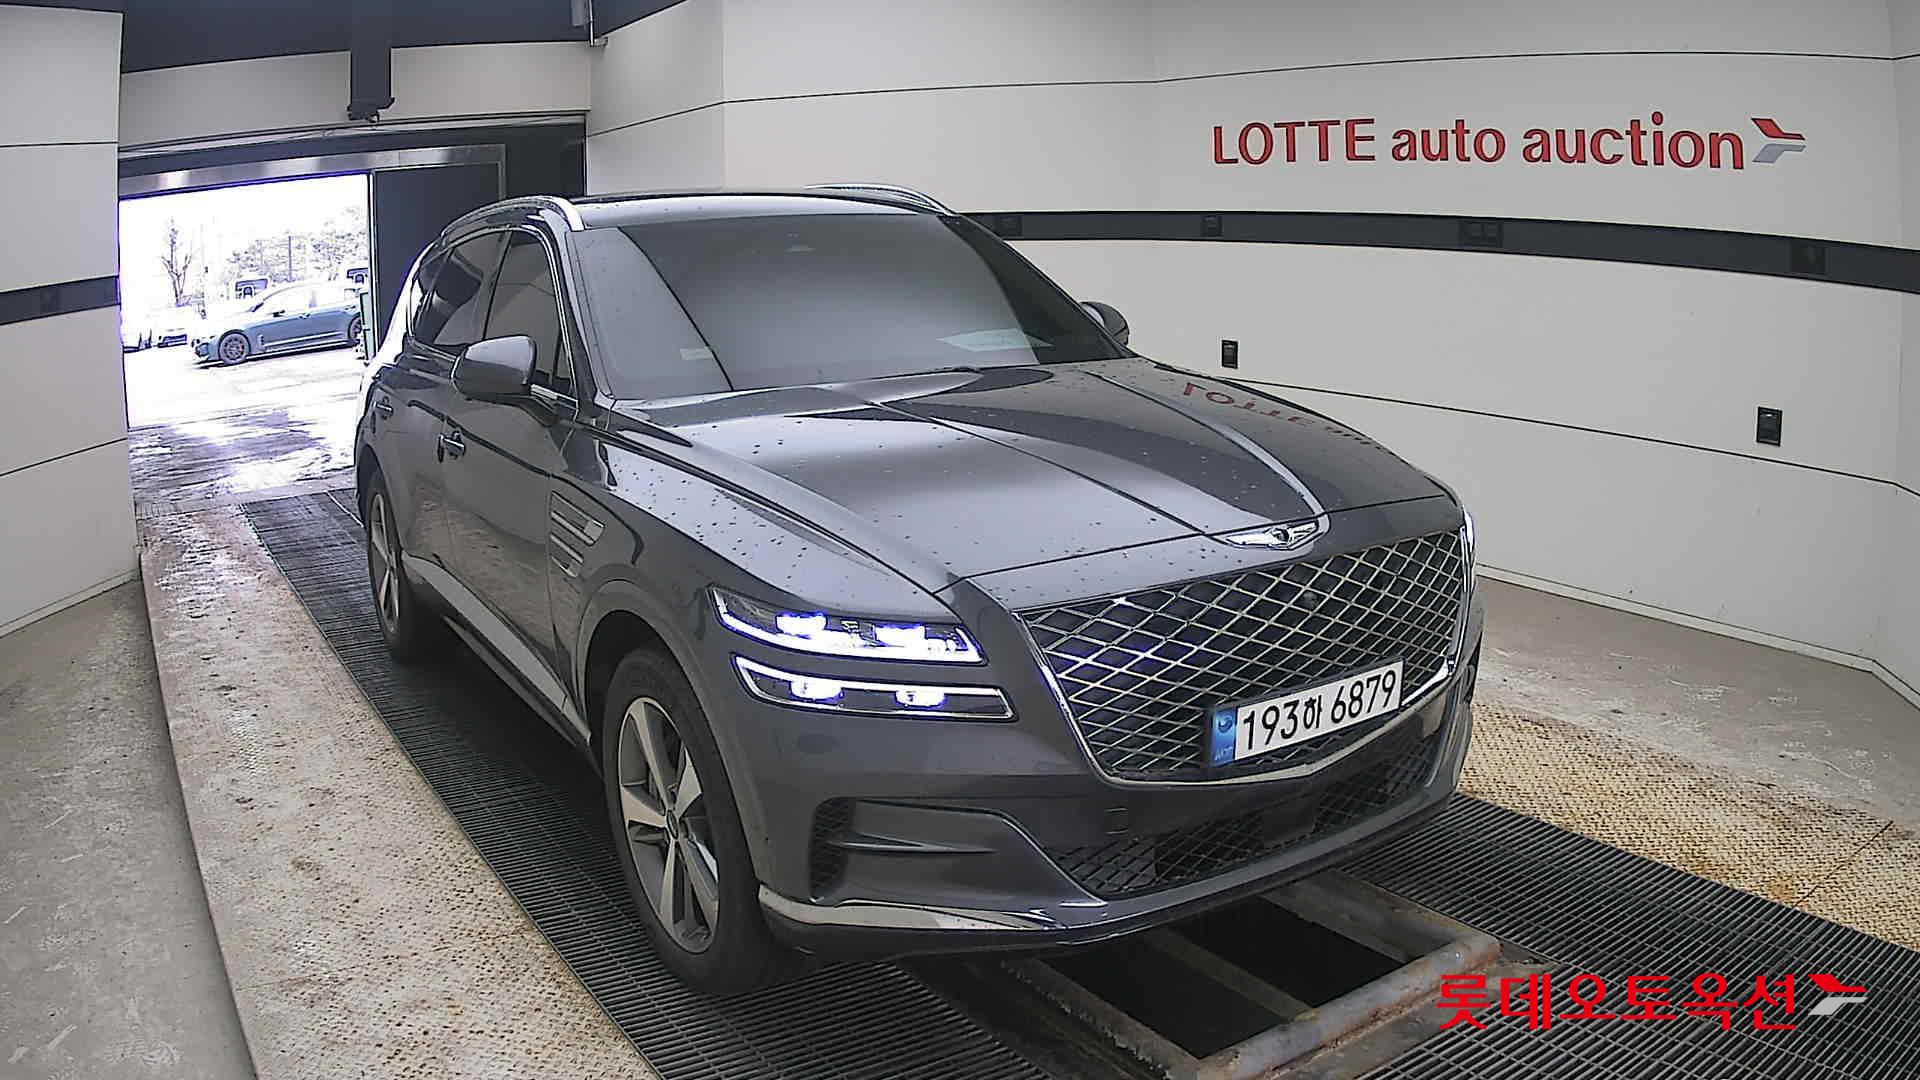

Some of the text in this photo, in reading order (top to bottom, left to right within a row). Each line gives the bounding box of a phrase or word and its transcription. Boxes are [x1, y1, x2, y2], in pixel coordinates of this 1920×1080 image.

[1213, 111, 1745, 170] LOTTE auto auction
[1243, 670, 1396, 750] 193하 6879
